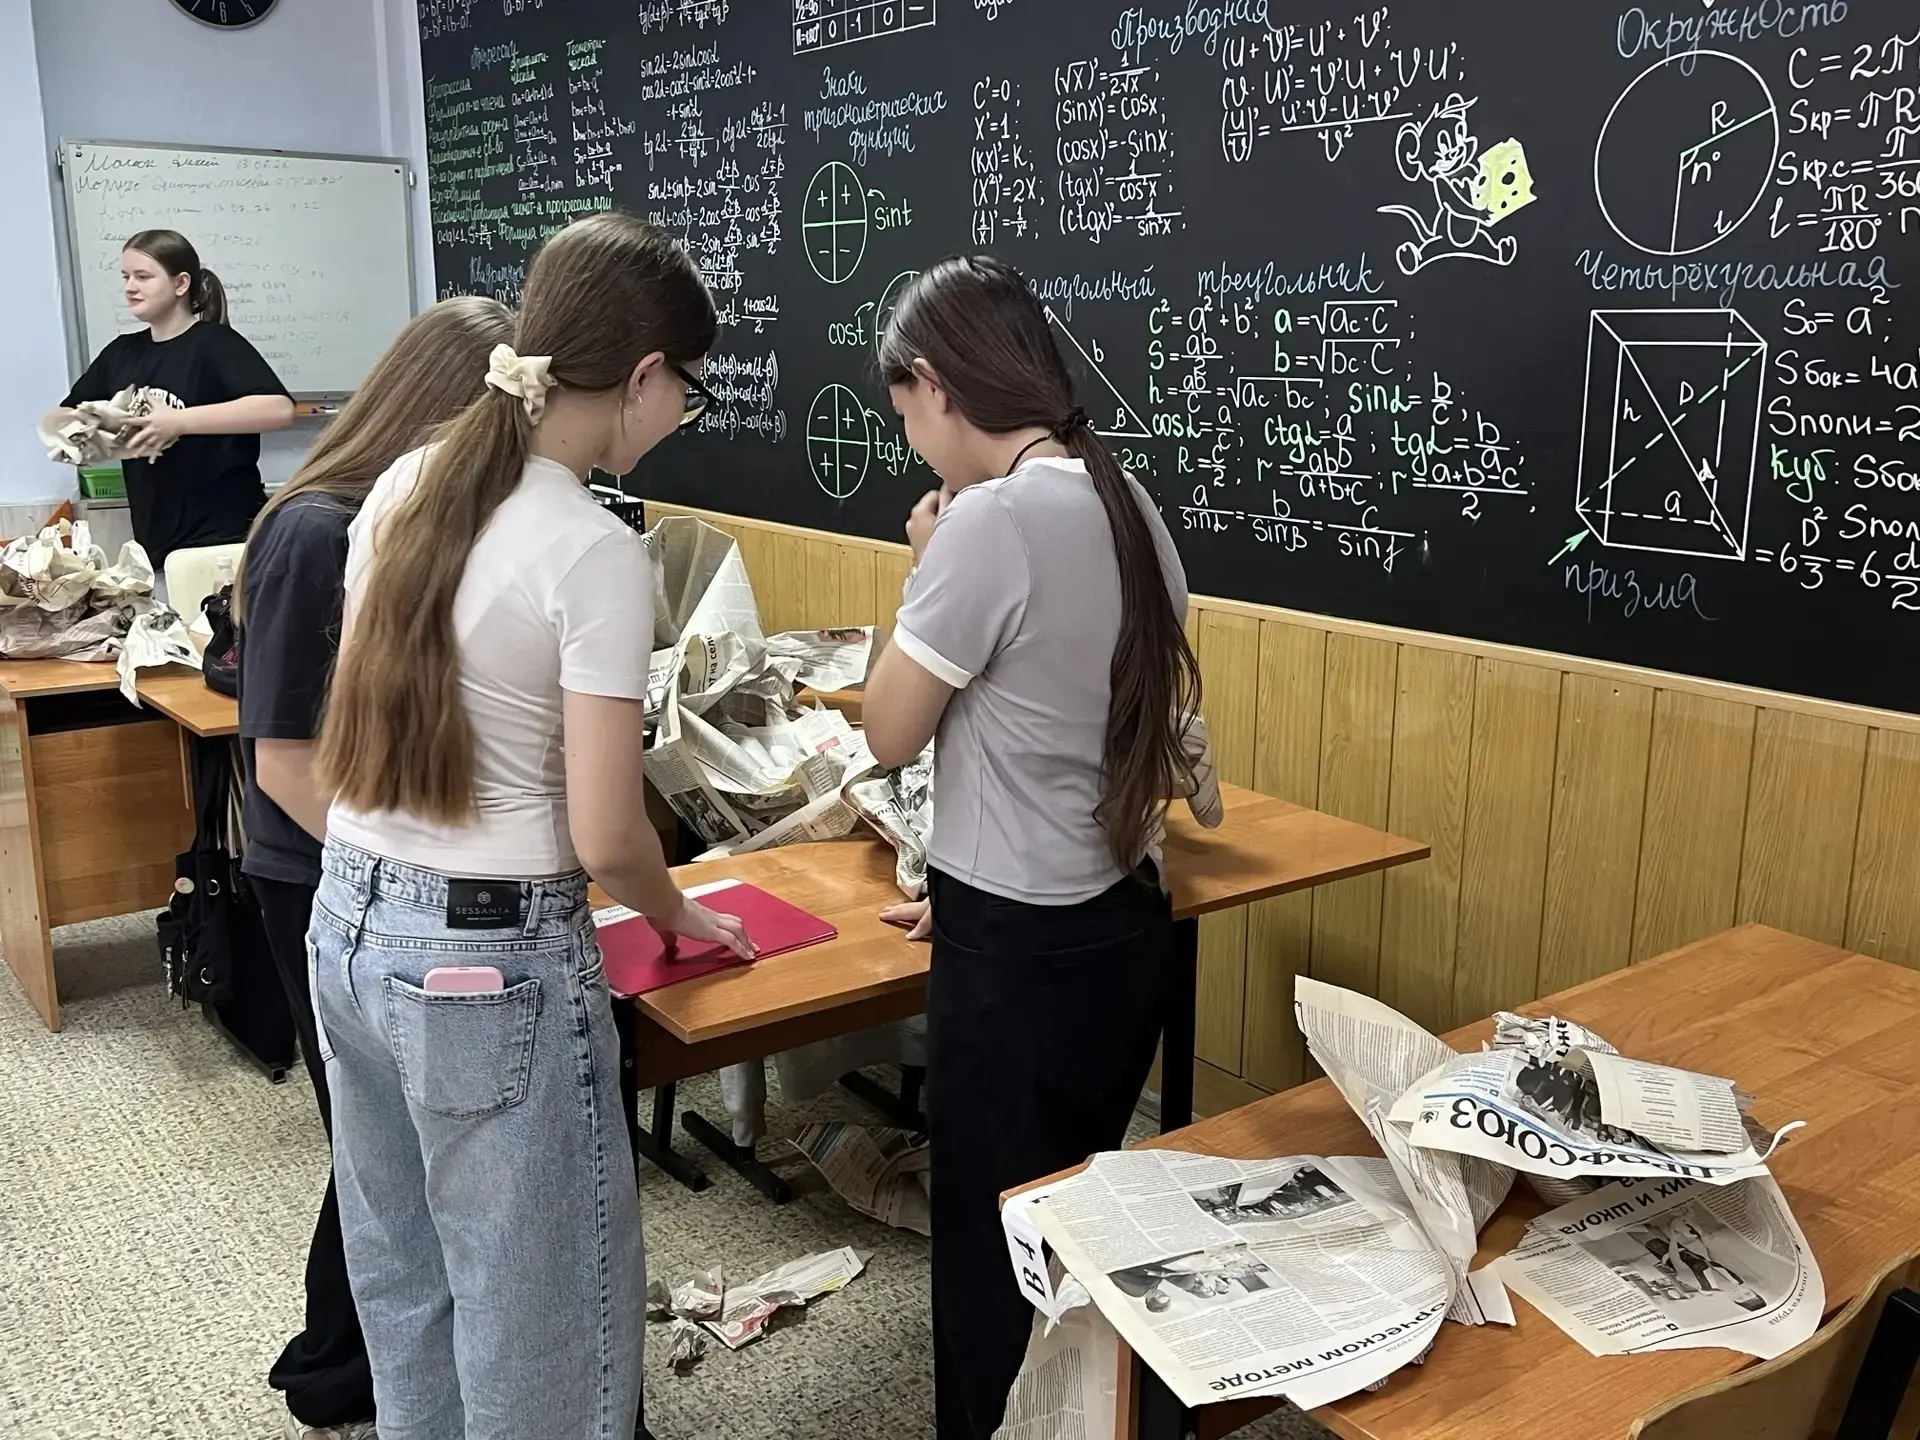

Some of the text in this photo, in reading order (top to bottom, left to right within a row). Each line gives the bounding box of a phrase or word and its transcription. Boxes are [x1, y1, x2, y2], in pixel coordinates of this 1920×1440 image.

[1617, 0, 1848, 77] Окружность
[820, 66, 867, 100] Знаки
[1198, 251, 1385, 309] треугольник
[1565, 560, 1720, 625] призма
[455, 907, 511, 915] SESSANTA
[1558, 1201, 1636, 1236] школа
[1210, 1357, 1315, 1392] методе
